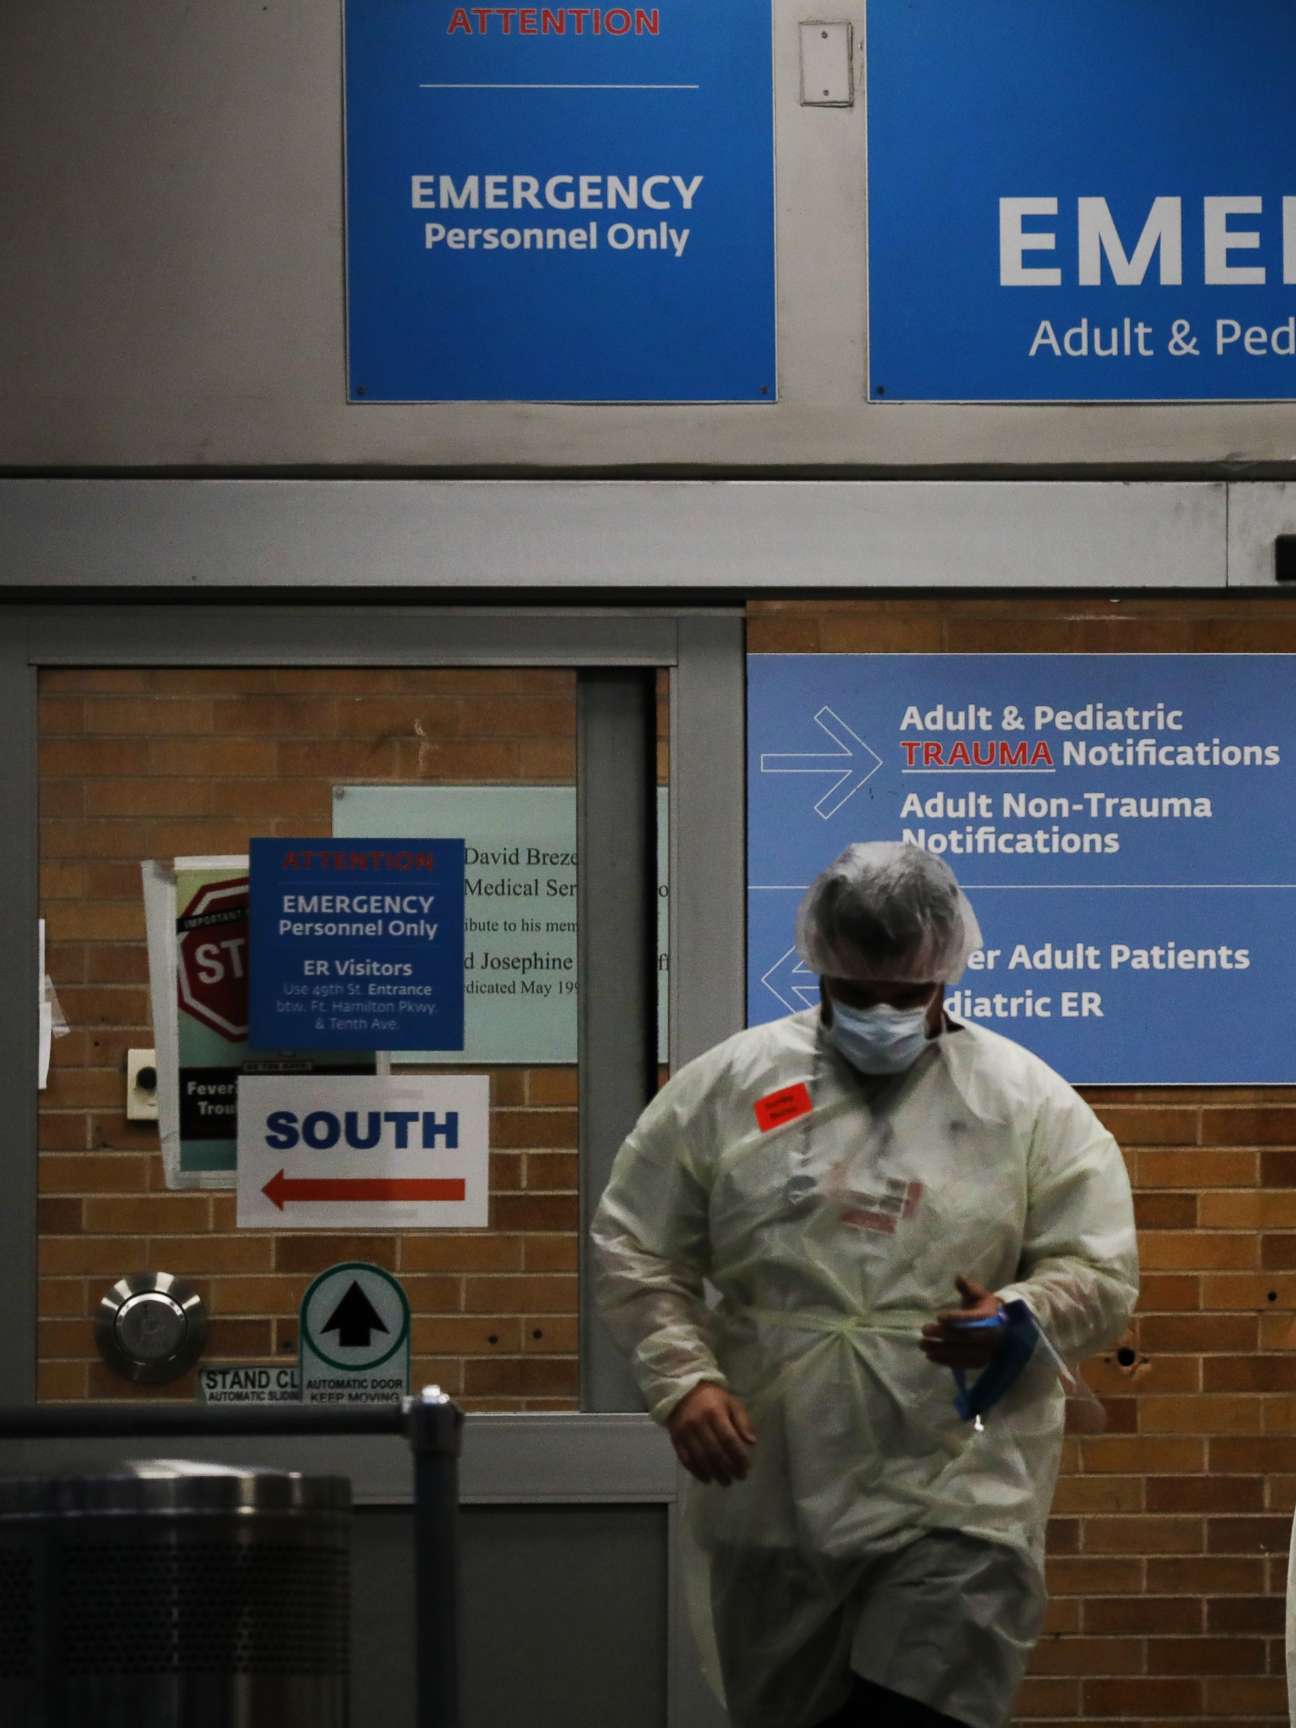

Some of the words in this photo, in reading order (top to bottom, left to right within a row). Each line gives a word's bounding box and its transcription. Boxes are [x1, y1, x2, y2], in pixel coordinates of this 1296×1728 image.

[447, 8, 660, 35] ATTENTION
[411, 175, 704, 209] EMERGENCY
[425, 221, 597, 250] Personnel
[607, 221, 690, 257] Only
[1029, 318, 1153, 357] Adult
[1168, 321, 1201, 356] &
[900, 704, 992, 731] Adult
[1001, 705, 1025, 731] &
[1034, 703, 1183, 731] Pediatric
[900, 741, 1054, 767] TRAUMA
[1063, 737, 1280, 766] Notifications
[900, 792, 993, 818] Adult
[1003, 792, 1213, 818] Non-Trauma
[902, 826, 1120, 854] Notifications
[282, 851, 434, 871] ATTENTION
[464, 848, 519, 866] David
[464, 879, 538, 897] Medical
[283, 895, 434, 913] EMERGENCY
[279, 920, 382, 936] Personnel
[388, 920, 438, 940] Only
[464, 918, 499, 932] ibute
[503, 919, 517, 932] to
[521, 918, 541, 932] his
[546, 922, 578, 932] mem
[195, 937, 246, 984] ST
[481, 952, 573, 974] Josephine
[1008, 944, 1100, 970] Adult
[1110, 942, 1250, 970] Patients
[304, 960, 330, 976] ER
[335, 958, 413, 976] Visitors
[368, 983, 432, 996] Entrance
[465, 980, 516, 994] dicated
[521, 981, 551, 997] May
[332, 1000, 395, 1013] Hamilton
[943, 990, 1052, 1018] diatric
[1061, 991, 1104, 1018] ER
[198, 1101, 239, 1115] Trou
[265, 1111, 458, 1150] SOUTH
[206, 1370, 270, 1389] STAND
[306, 1379, 368, 1390] AUTOMATIC
[371, 1378, 403, 1389] DOOR
[209, 1391, 266, 1401] AUTOMATIC
[267, 1391, 301, 1401] SLIDIN
[310, 1392, 343, 1402] KEEP
[349, 1391, 400, 1402] MOVING
